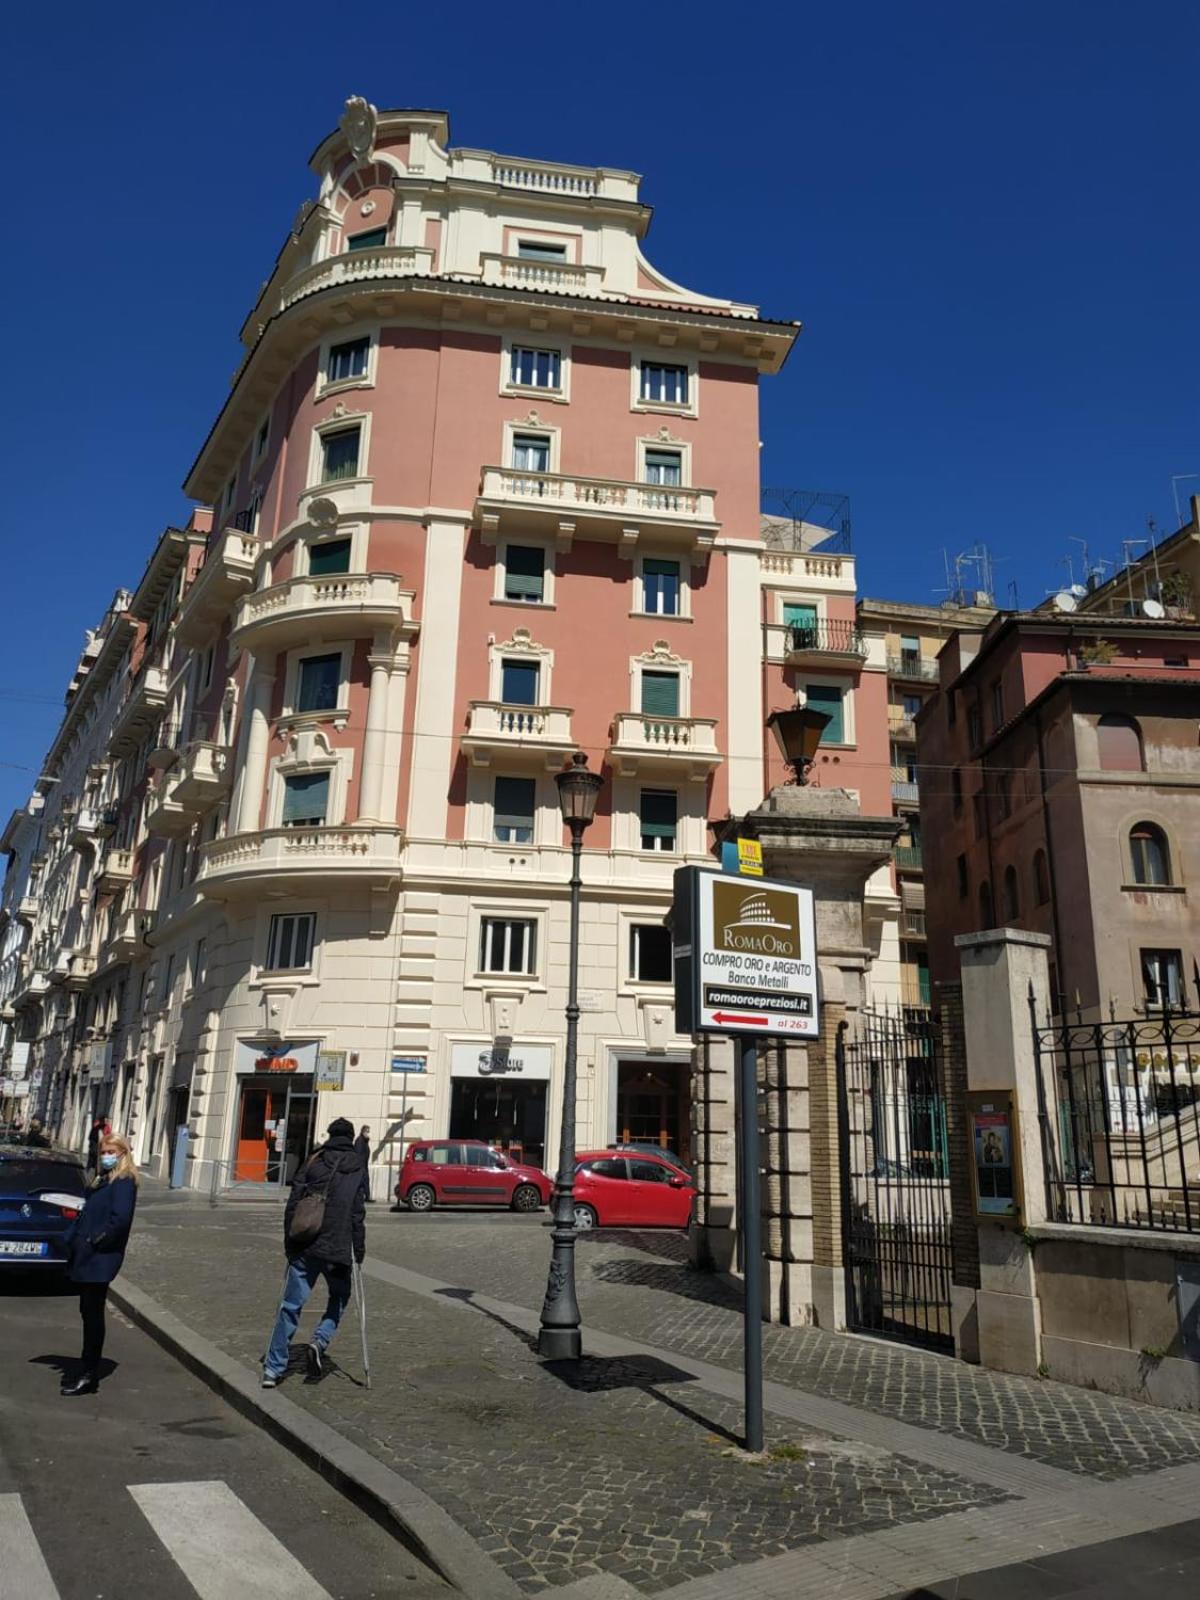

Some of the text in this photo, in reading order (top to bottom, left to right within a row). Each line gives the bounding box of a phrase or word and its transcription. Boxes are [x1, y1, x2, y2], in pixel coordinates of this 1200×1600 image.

[703, 952, 811, 976] COMPRO ORO e ARGENTO
[728, 971, 789, 988] Banco Metalli
[709, 992, 808, 1010] romaoroepreziosi.it
[777, 1019, 808, 1030] al 263
